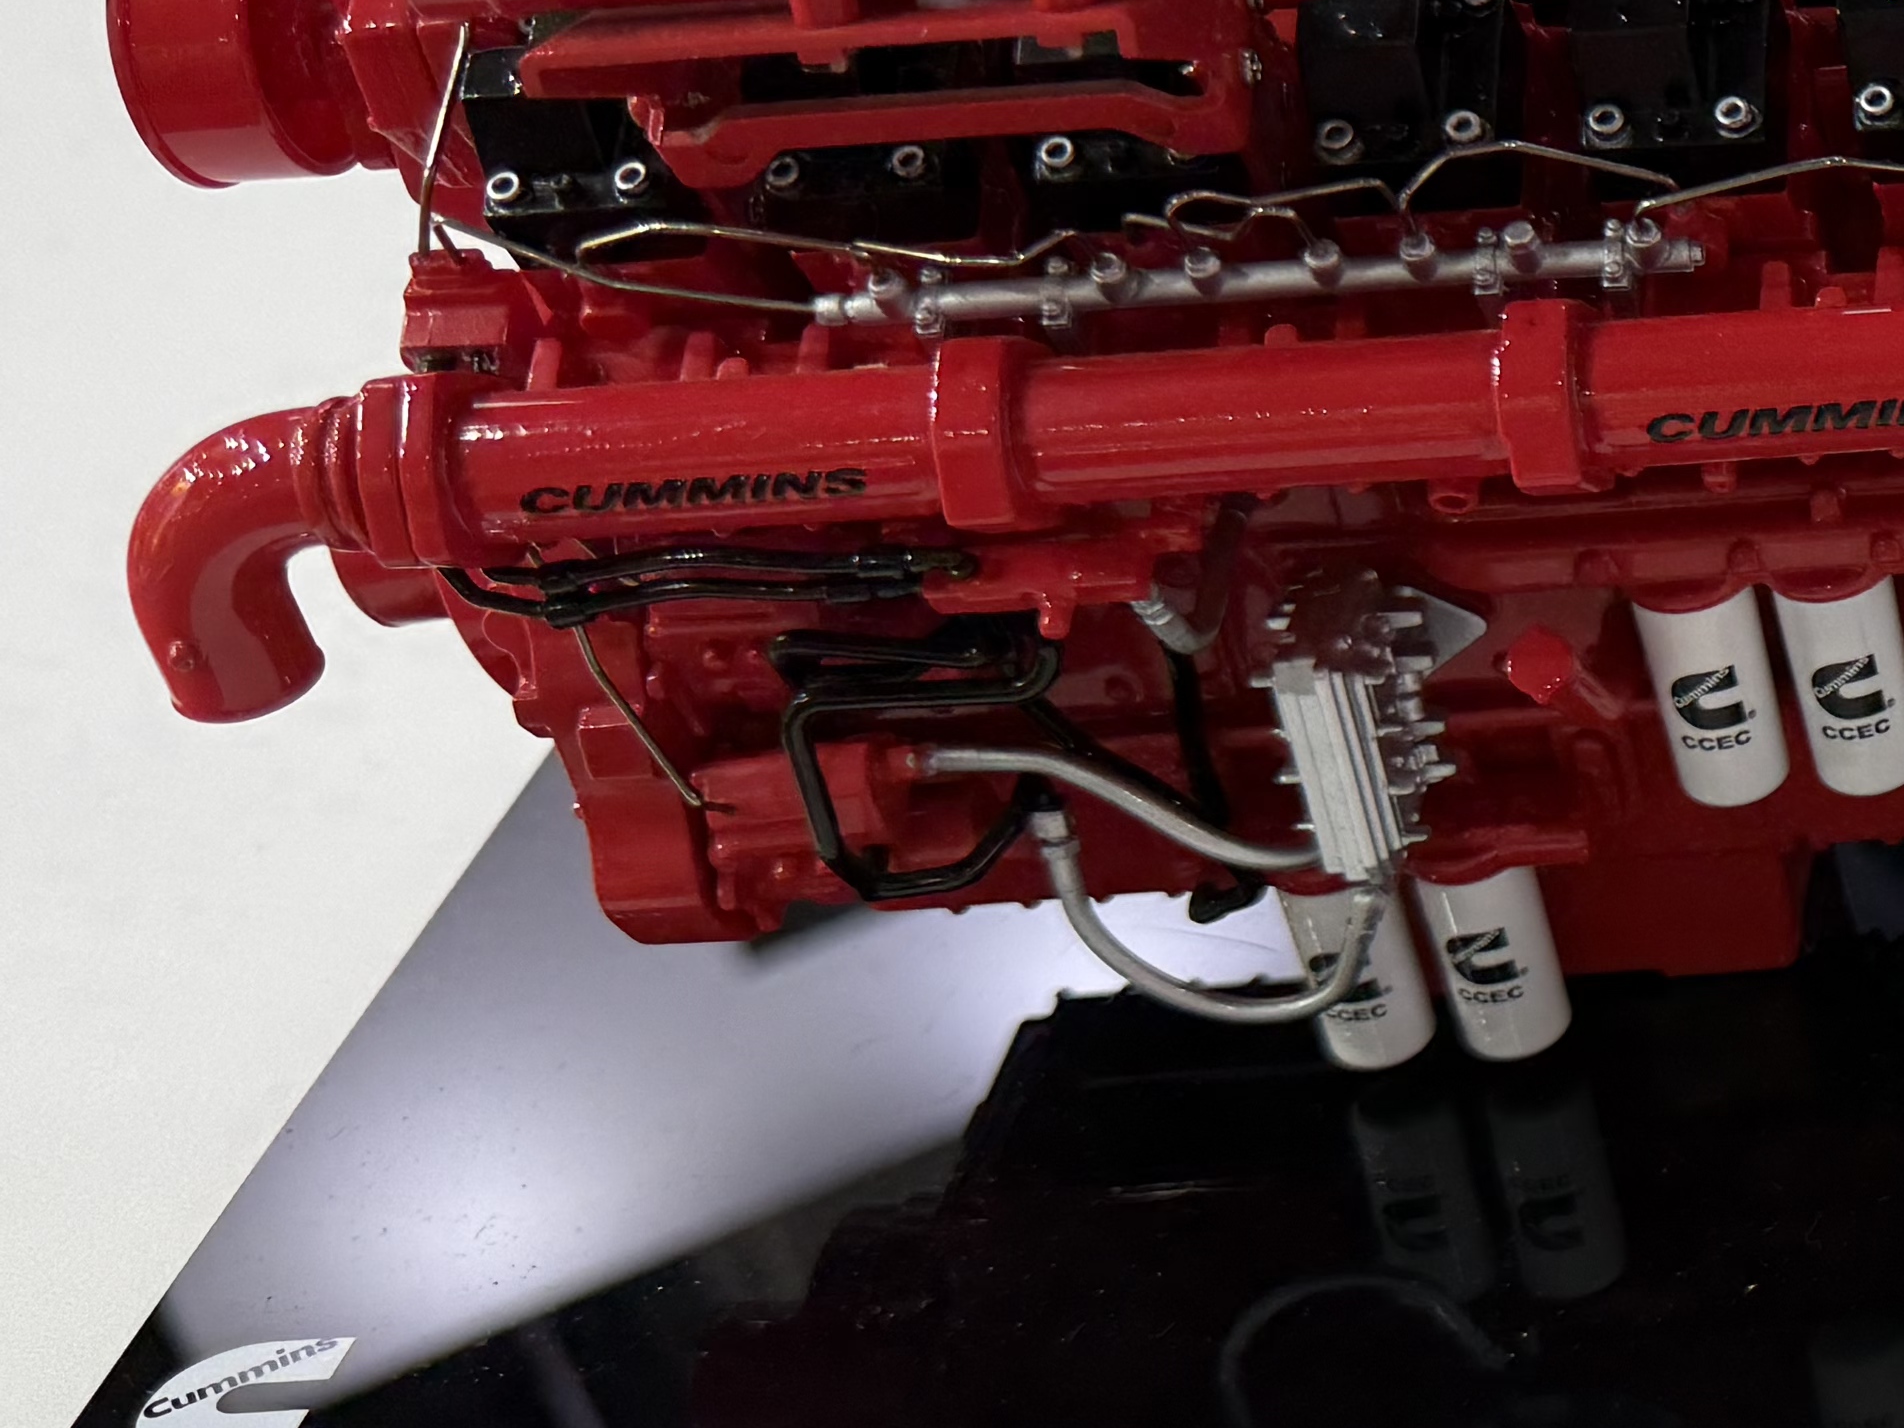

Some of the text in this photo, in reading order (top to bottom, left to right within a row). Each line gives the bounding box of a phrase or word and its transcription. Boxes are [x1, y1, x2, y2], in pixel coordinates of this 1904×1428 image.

[519, 466, 868, 514] CUMMINS
[1681, 729, 1752, 751] CCEC
[1821, 718, 1891, 741] CCEC
[1458, 985, 1524, 1004] CCEC
[142, 1337, 339, 1420] Cummins
